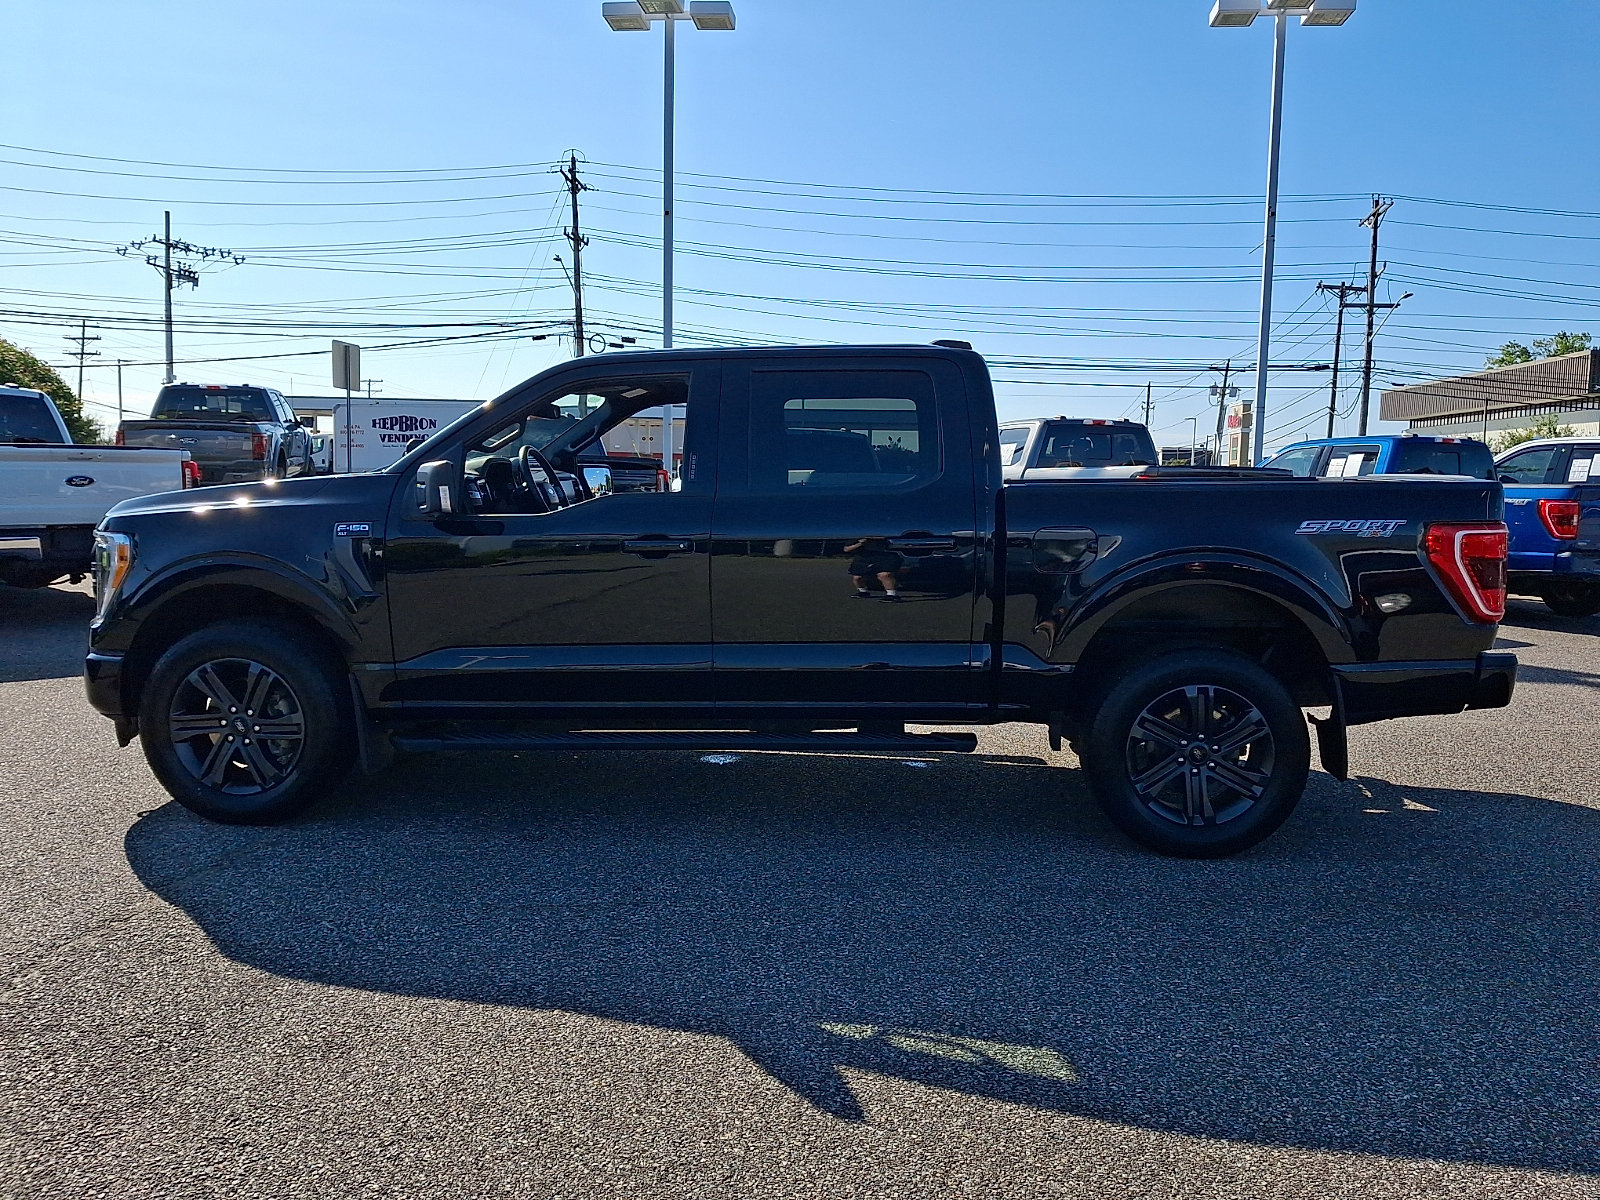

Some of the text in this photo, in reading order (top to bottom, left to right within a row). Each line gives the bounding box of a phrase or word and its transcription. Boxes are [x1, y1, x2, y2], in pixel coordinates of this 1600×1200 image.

[371, 415, 437, 432] HEPBRON
[379, 433, 430, 442] VENDING
[1295, 519, 1407, 534] SPORT
